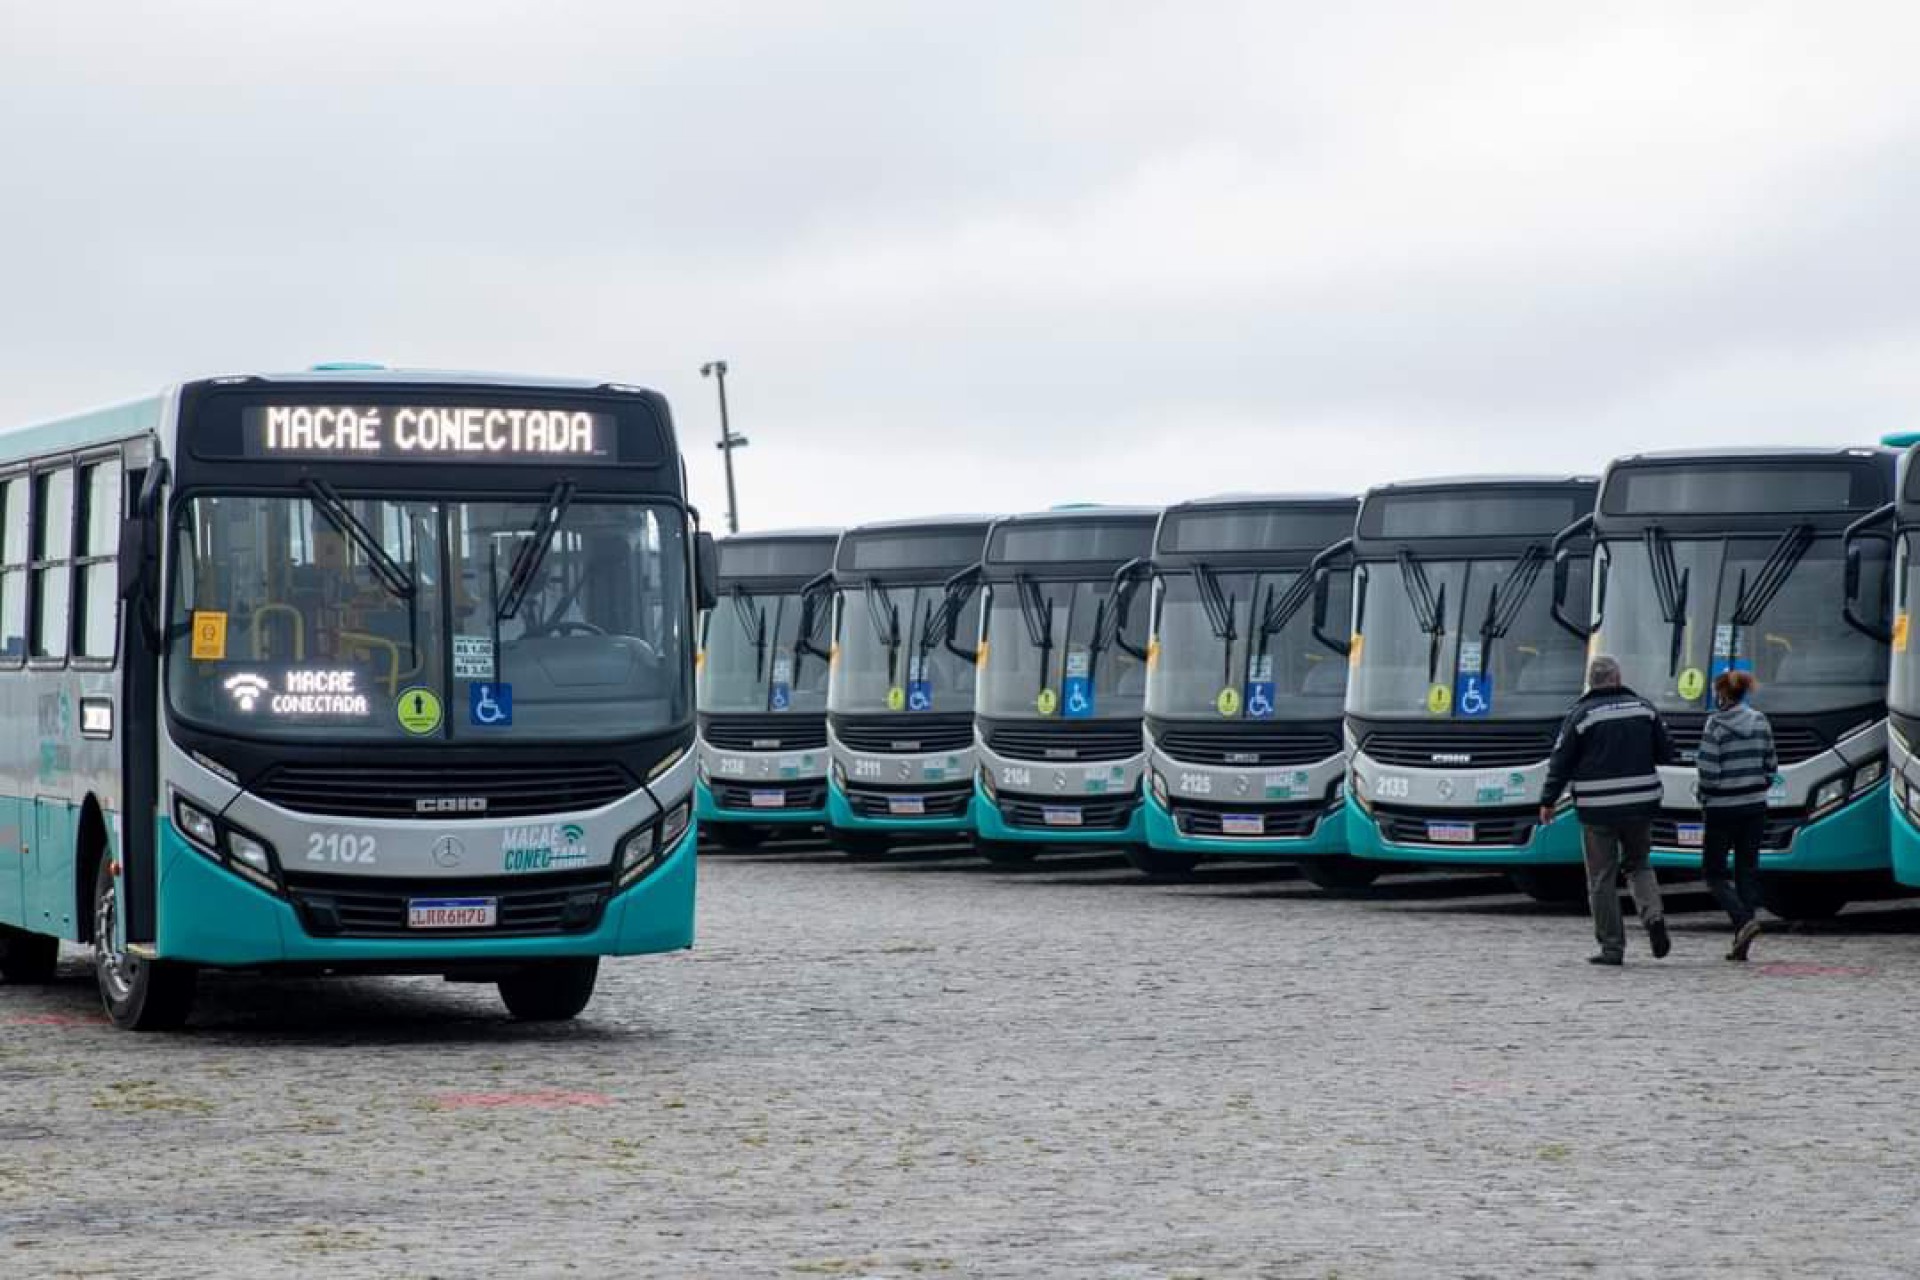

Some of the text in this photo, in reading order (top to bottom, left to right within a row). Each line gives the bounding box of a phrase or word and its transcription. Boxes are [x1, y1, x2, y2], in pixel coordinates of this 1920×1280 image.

[395, 408, 594, 452] CONECTADA
[272, 695, 368, 713] CONECTADA
[416, 798, 488, 811] CAIO
[306, 832, 377, 863] 2102
